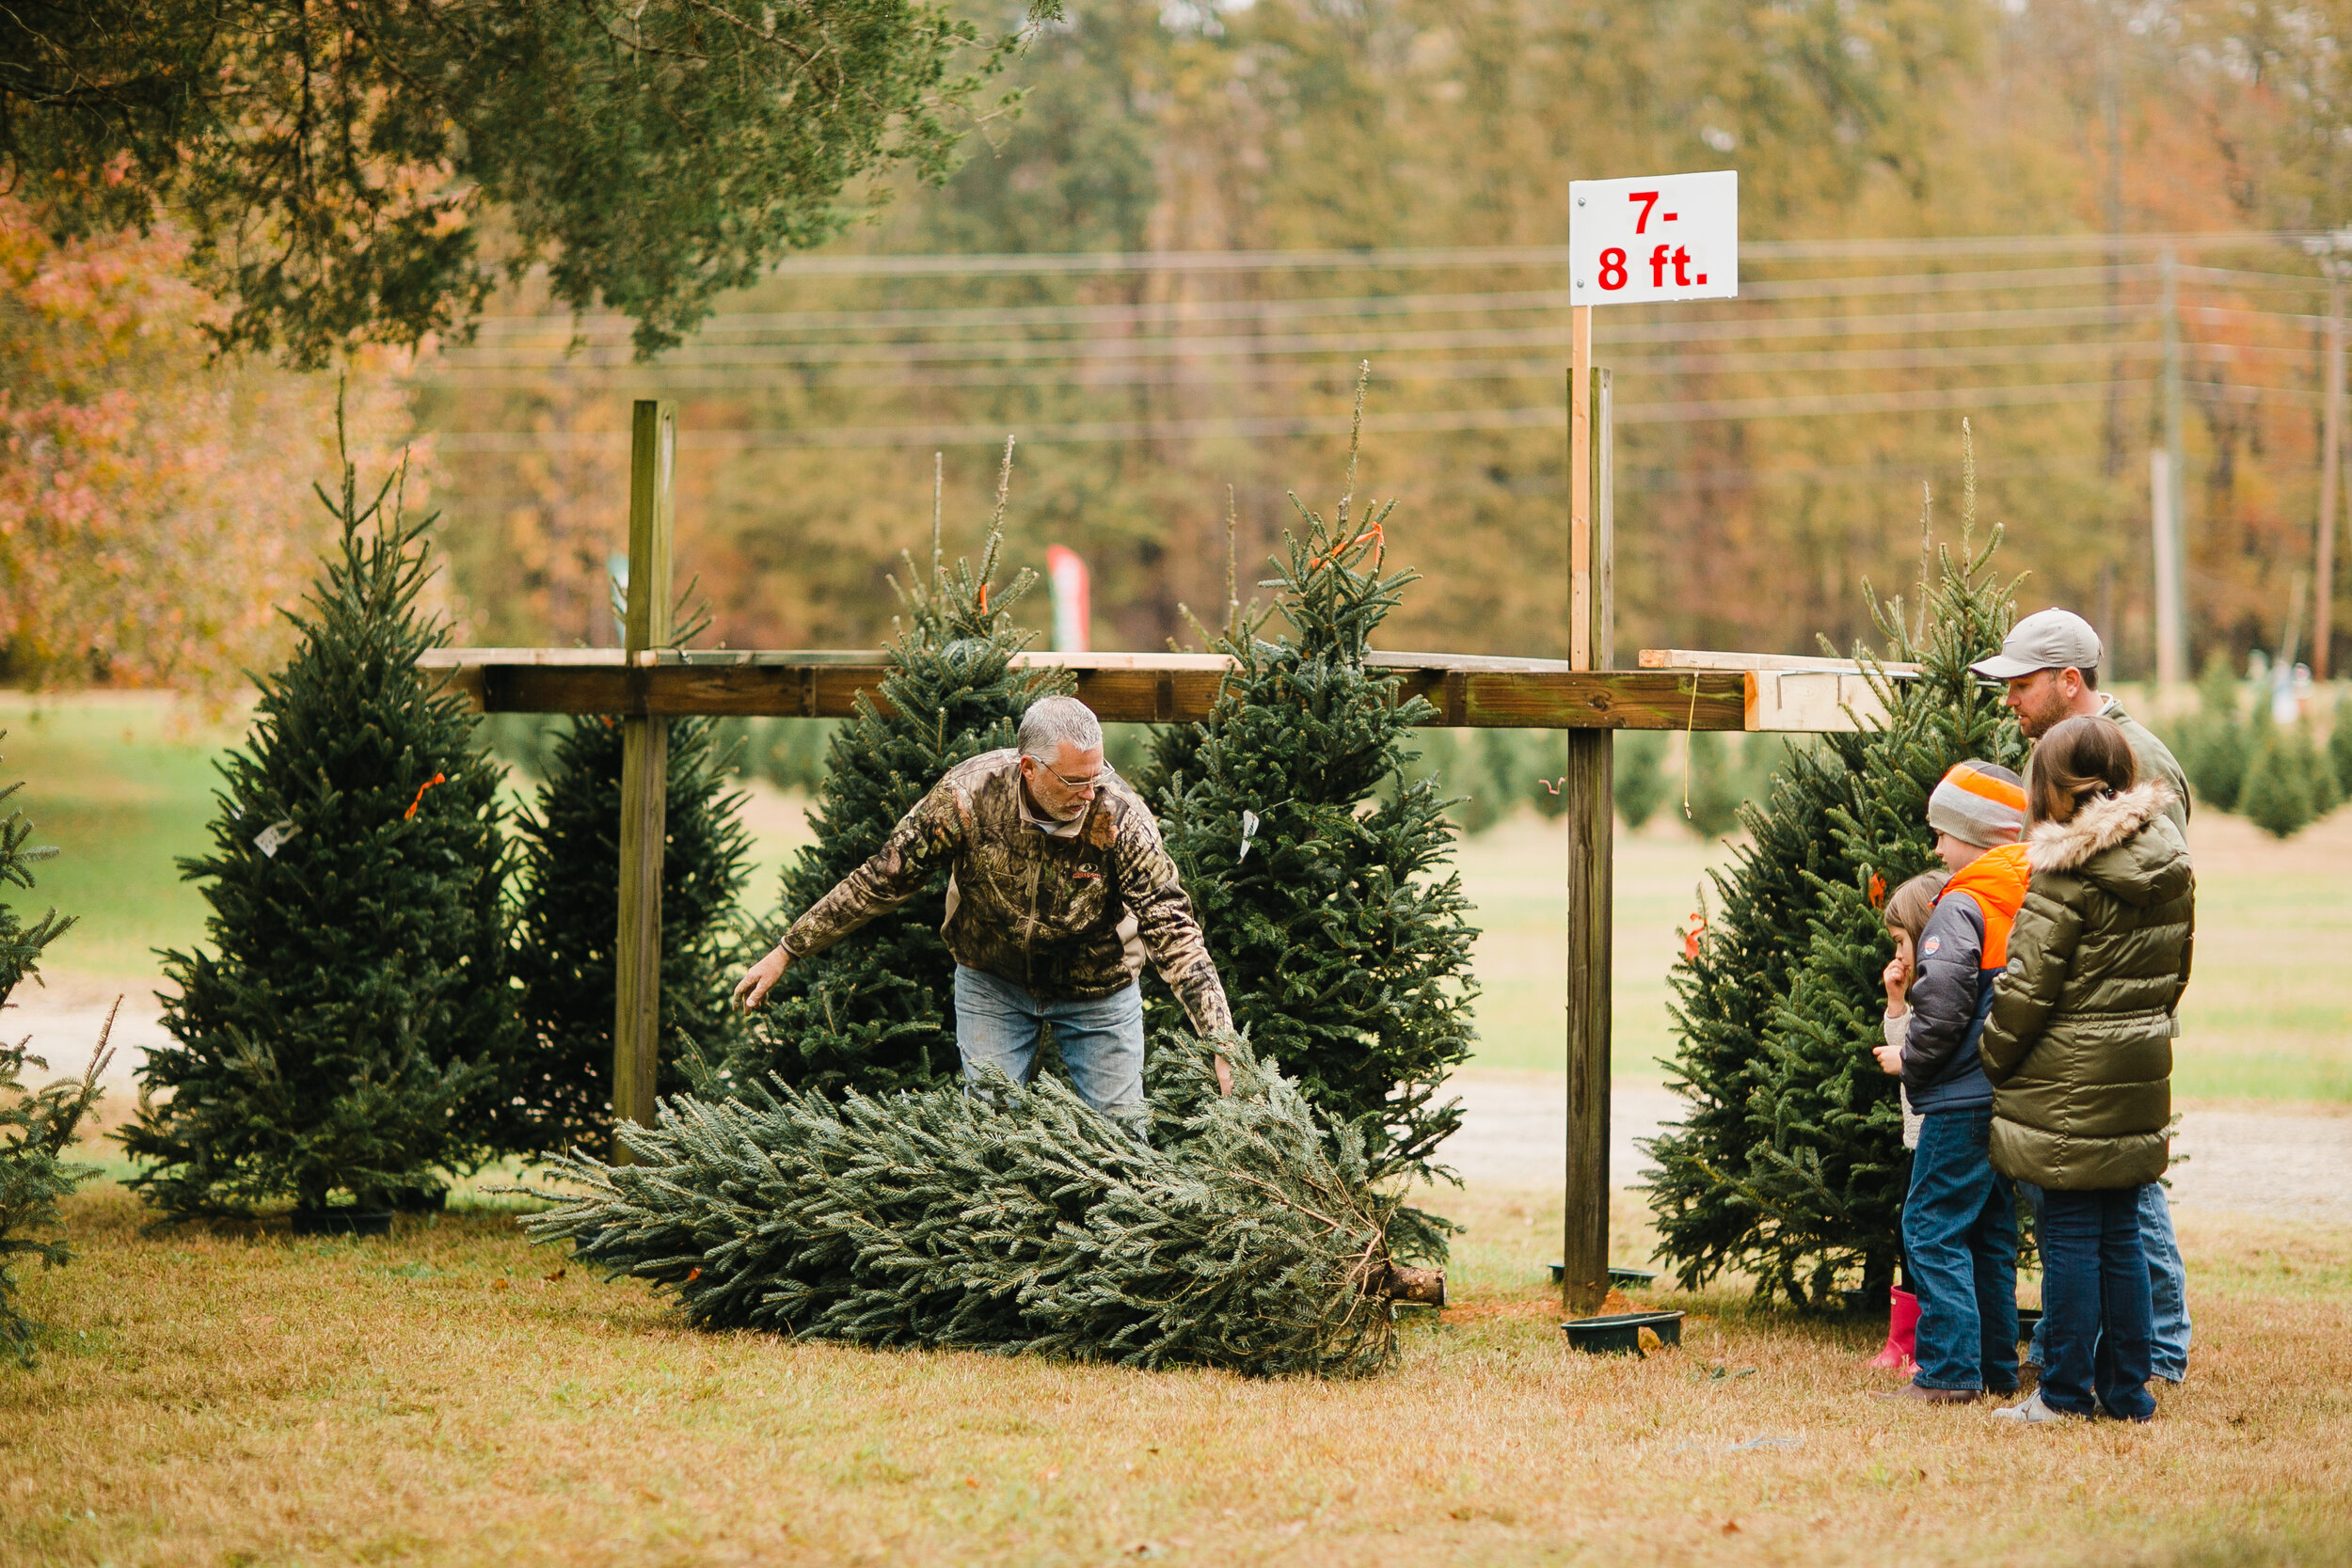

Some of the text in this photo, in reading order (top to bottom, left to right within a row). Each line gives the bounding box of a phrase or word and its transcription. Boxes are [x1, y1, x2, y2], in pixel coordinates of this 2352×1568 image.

[1629, 191, 1678, 234] 7-
[1597, 244, 1708, 291] 8 ft.
